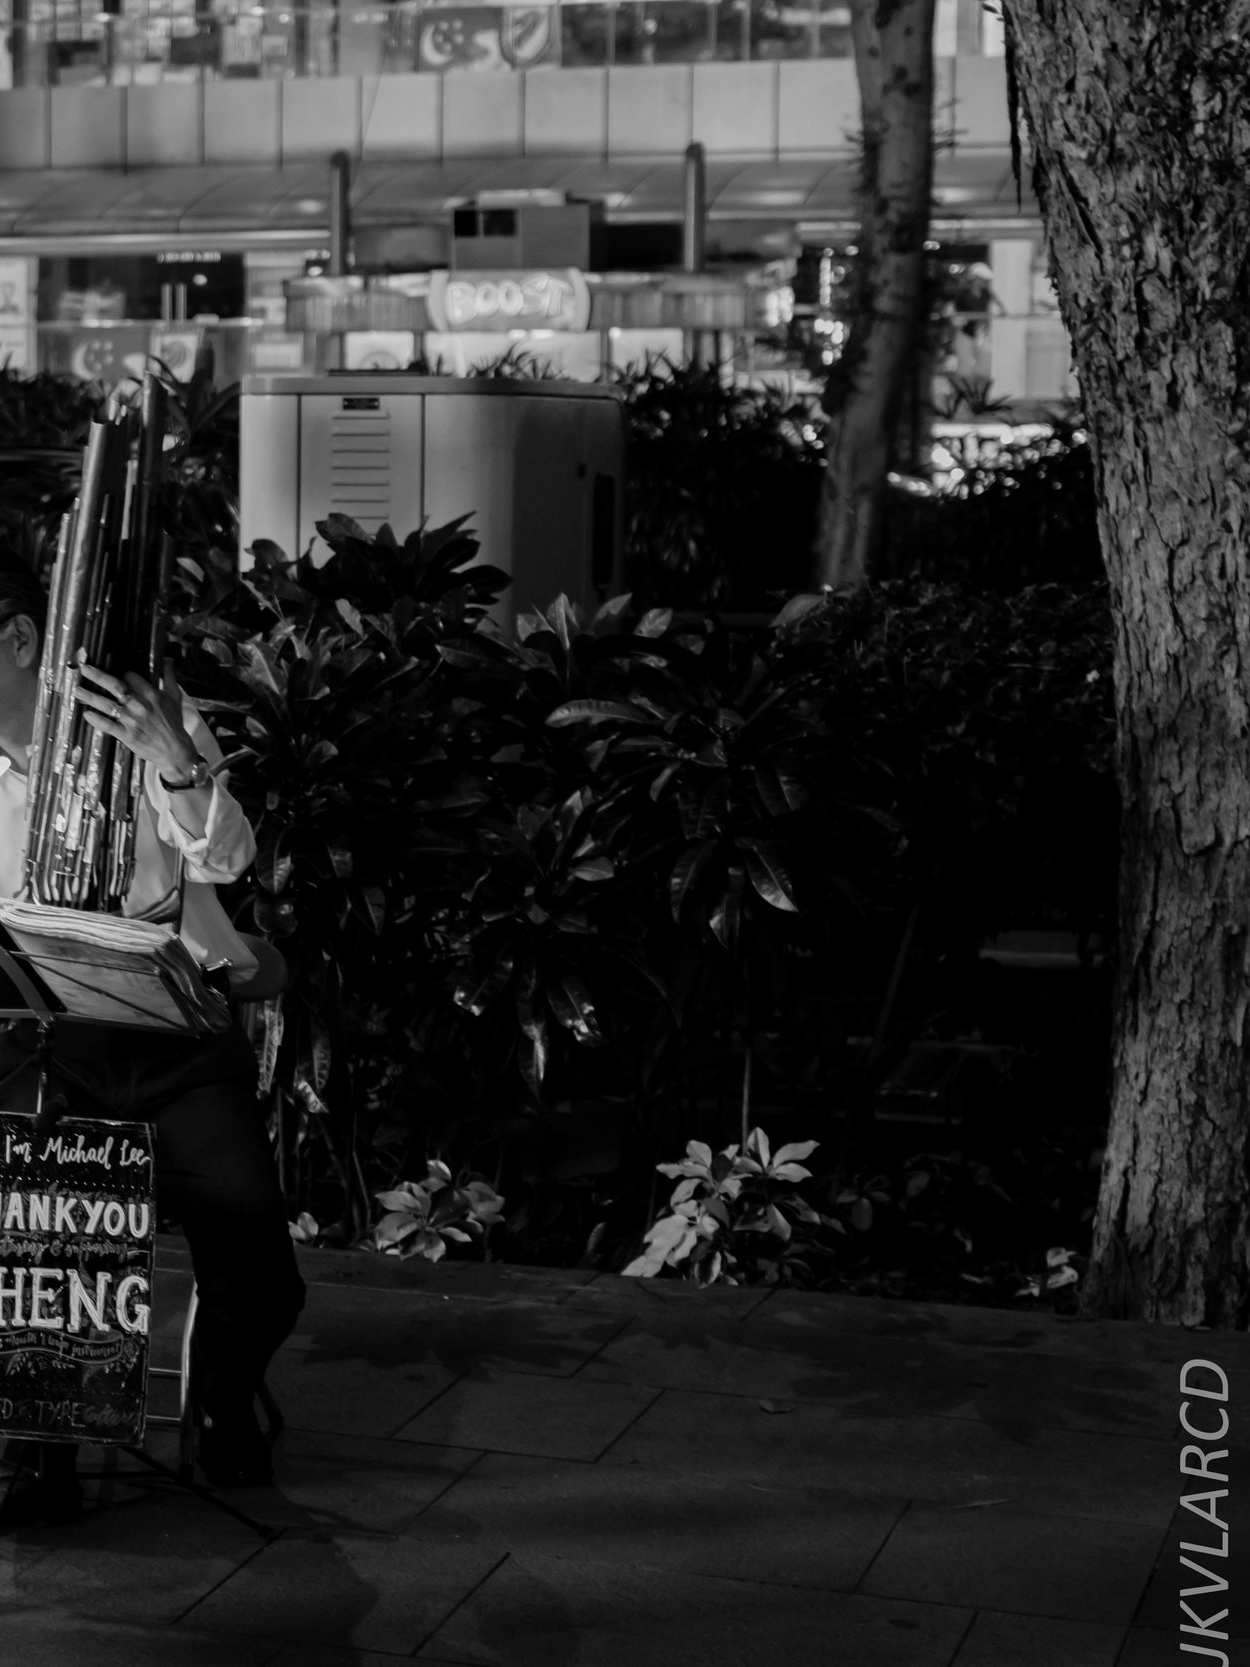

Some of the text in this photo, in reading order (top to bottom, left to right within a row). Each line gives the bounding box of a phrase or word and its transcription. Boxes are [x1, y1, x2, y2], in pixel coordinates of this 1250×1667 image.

[445, 272, 574, 325] BOOST
[38, 1135, 114, 1170] Michael
[119, 1138, 152, 1167] Lee
